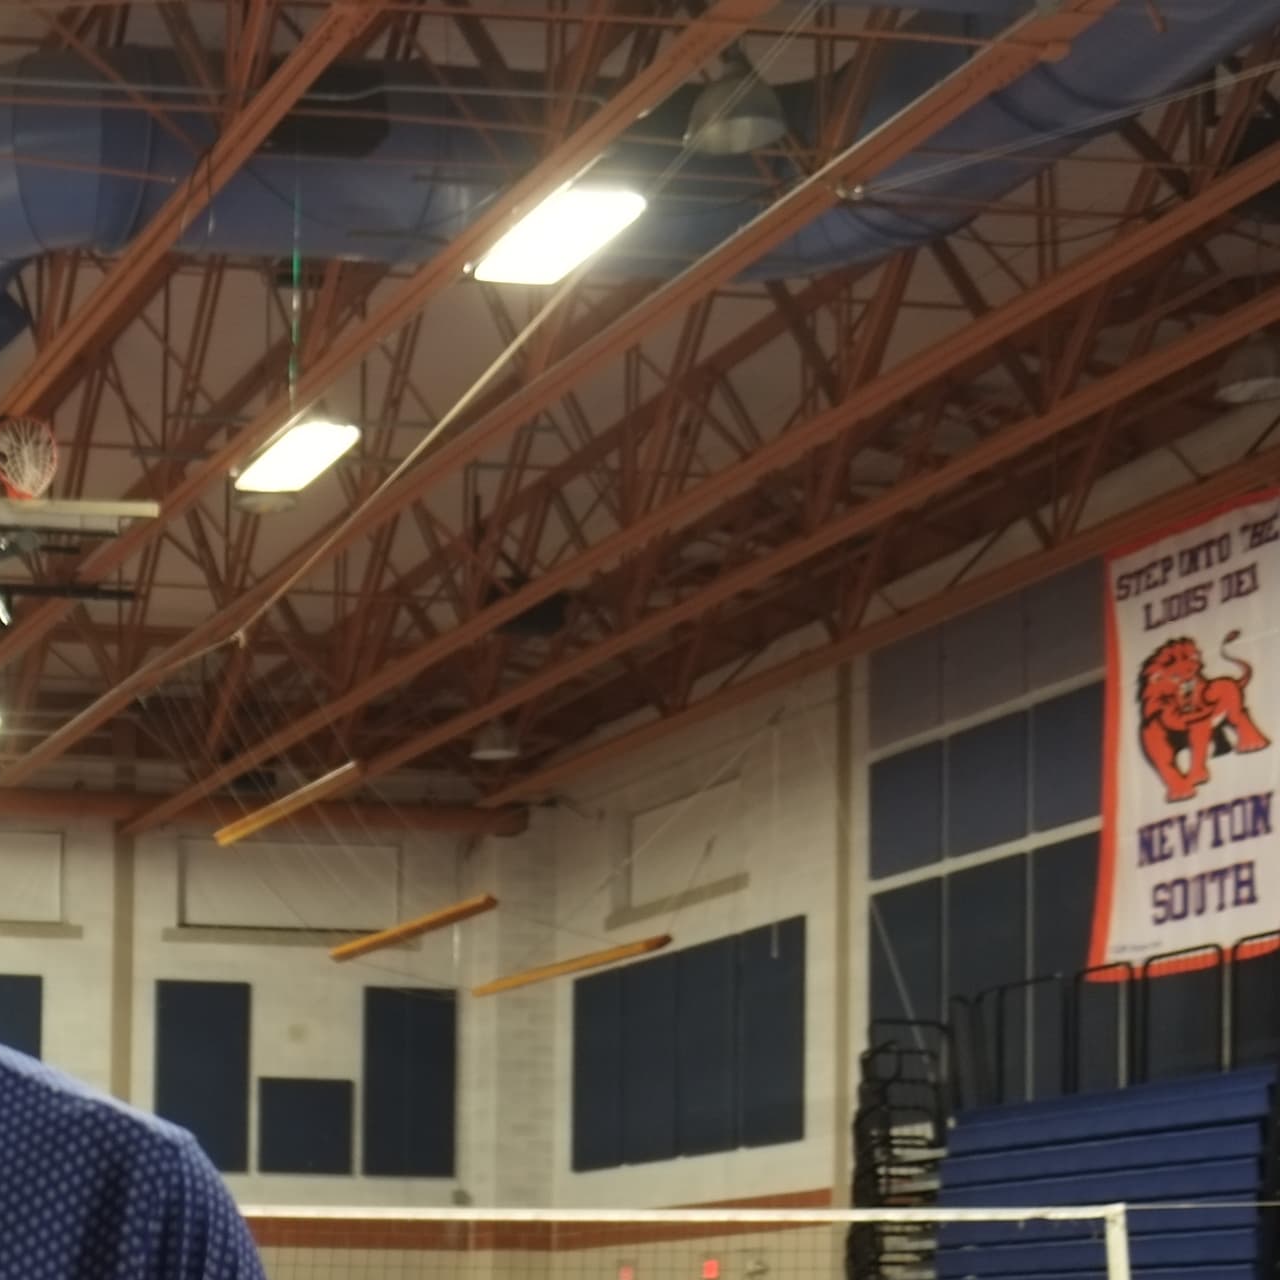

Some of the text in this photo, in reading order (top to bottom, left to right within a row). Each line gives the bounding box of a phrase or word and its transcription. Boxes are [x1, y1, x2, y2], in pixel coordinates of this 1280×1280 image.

[1115, 555, 1174, 603] STEP
[1137, 790, 1273, 868] NEWTON
[1151, 861, 1258, 926] SOUTH
